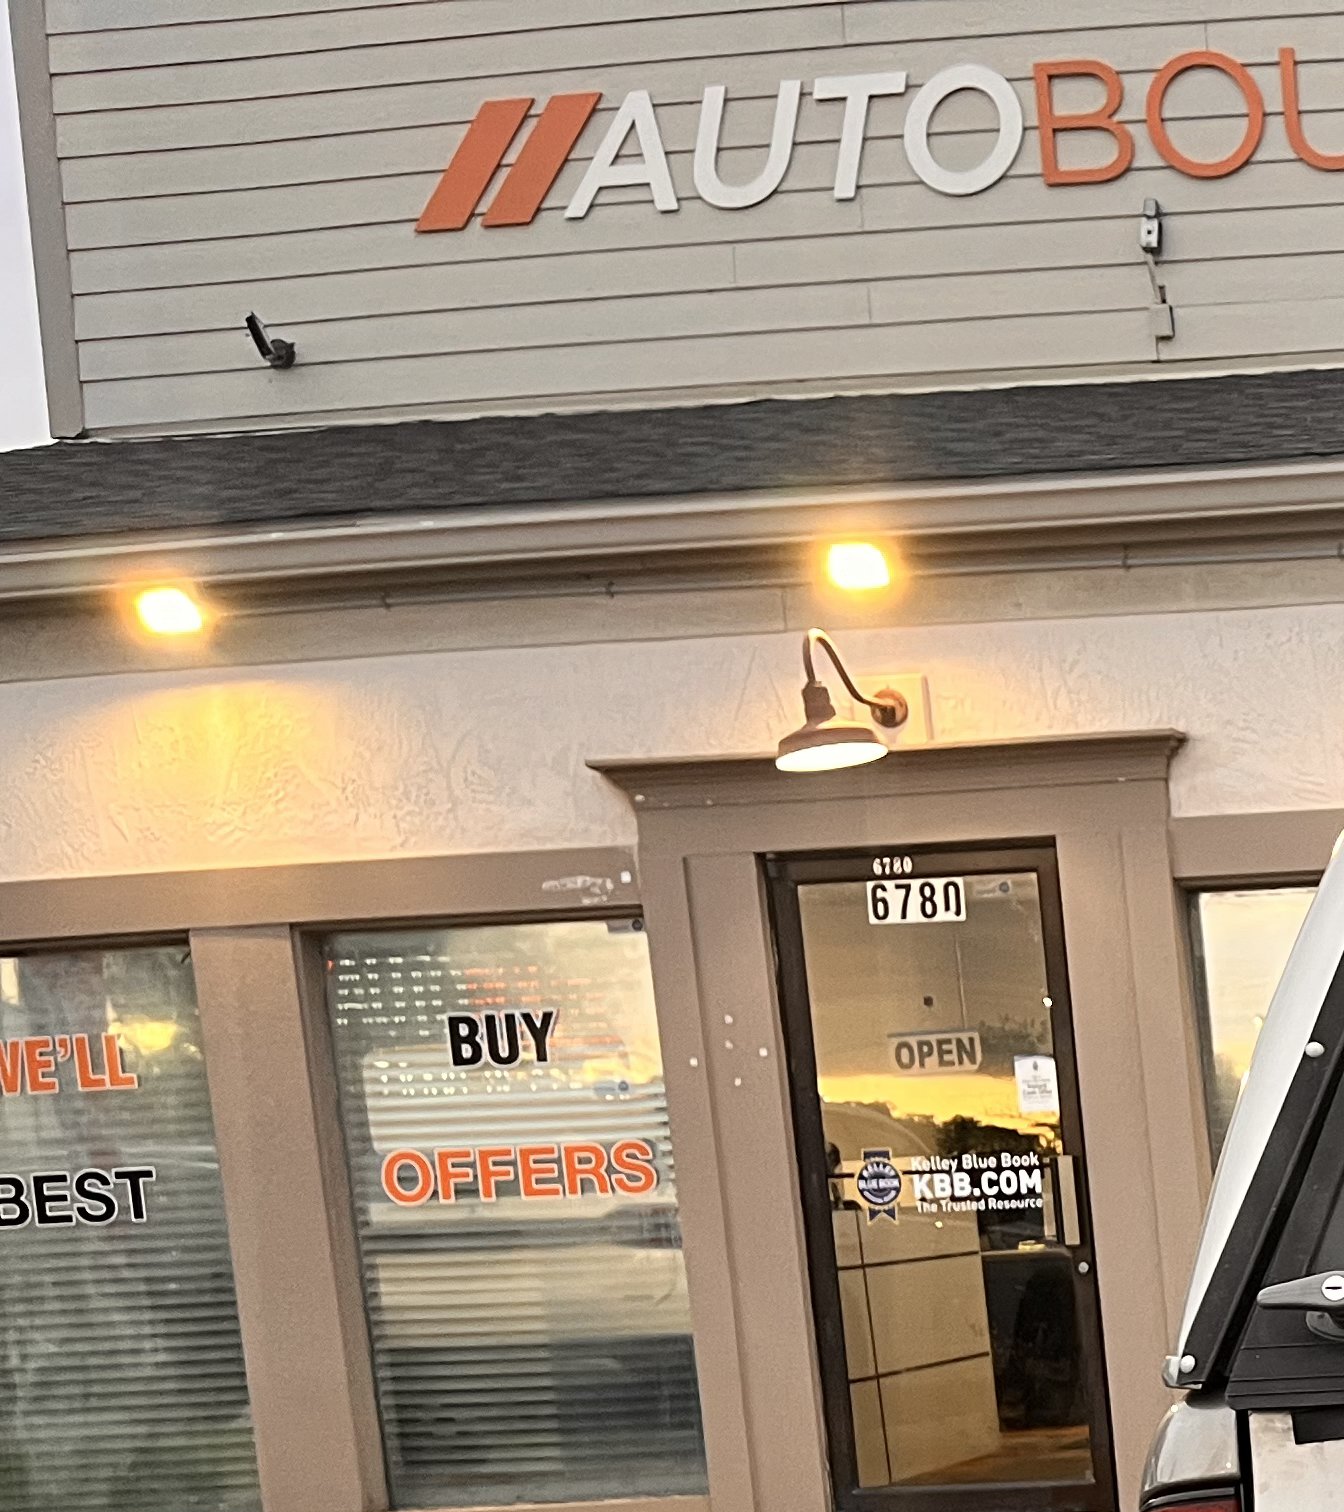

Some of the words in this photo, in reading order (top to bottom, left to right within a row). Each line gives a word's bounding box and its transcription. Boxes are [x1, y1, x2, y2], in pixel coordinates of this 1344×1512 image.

[872, 855, 913, 876] 6780
[447, 1008, 556, 1069] BUY
[894, 1036, 978, 1070] OPEN
[381, 1138, 659, 1207] OFFERS
[911, 1155, 958, 1173] Kelley
[961, 1153, 997, 1170] Blue
[1000, 1151, 1040, 1168] Book
[0, 1166, 156, 1231] BEST
[913, 1169, 1042, 1200] KBB.COM
[916, 1200, 938, 1214] The
[940, 1198, 985, 1213] Trusted
[987, 1197, 1044, 1211] Resource
